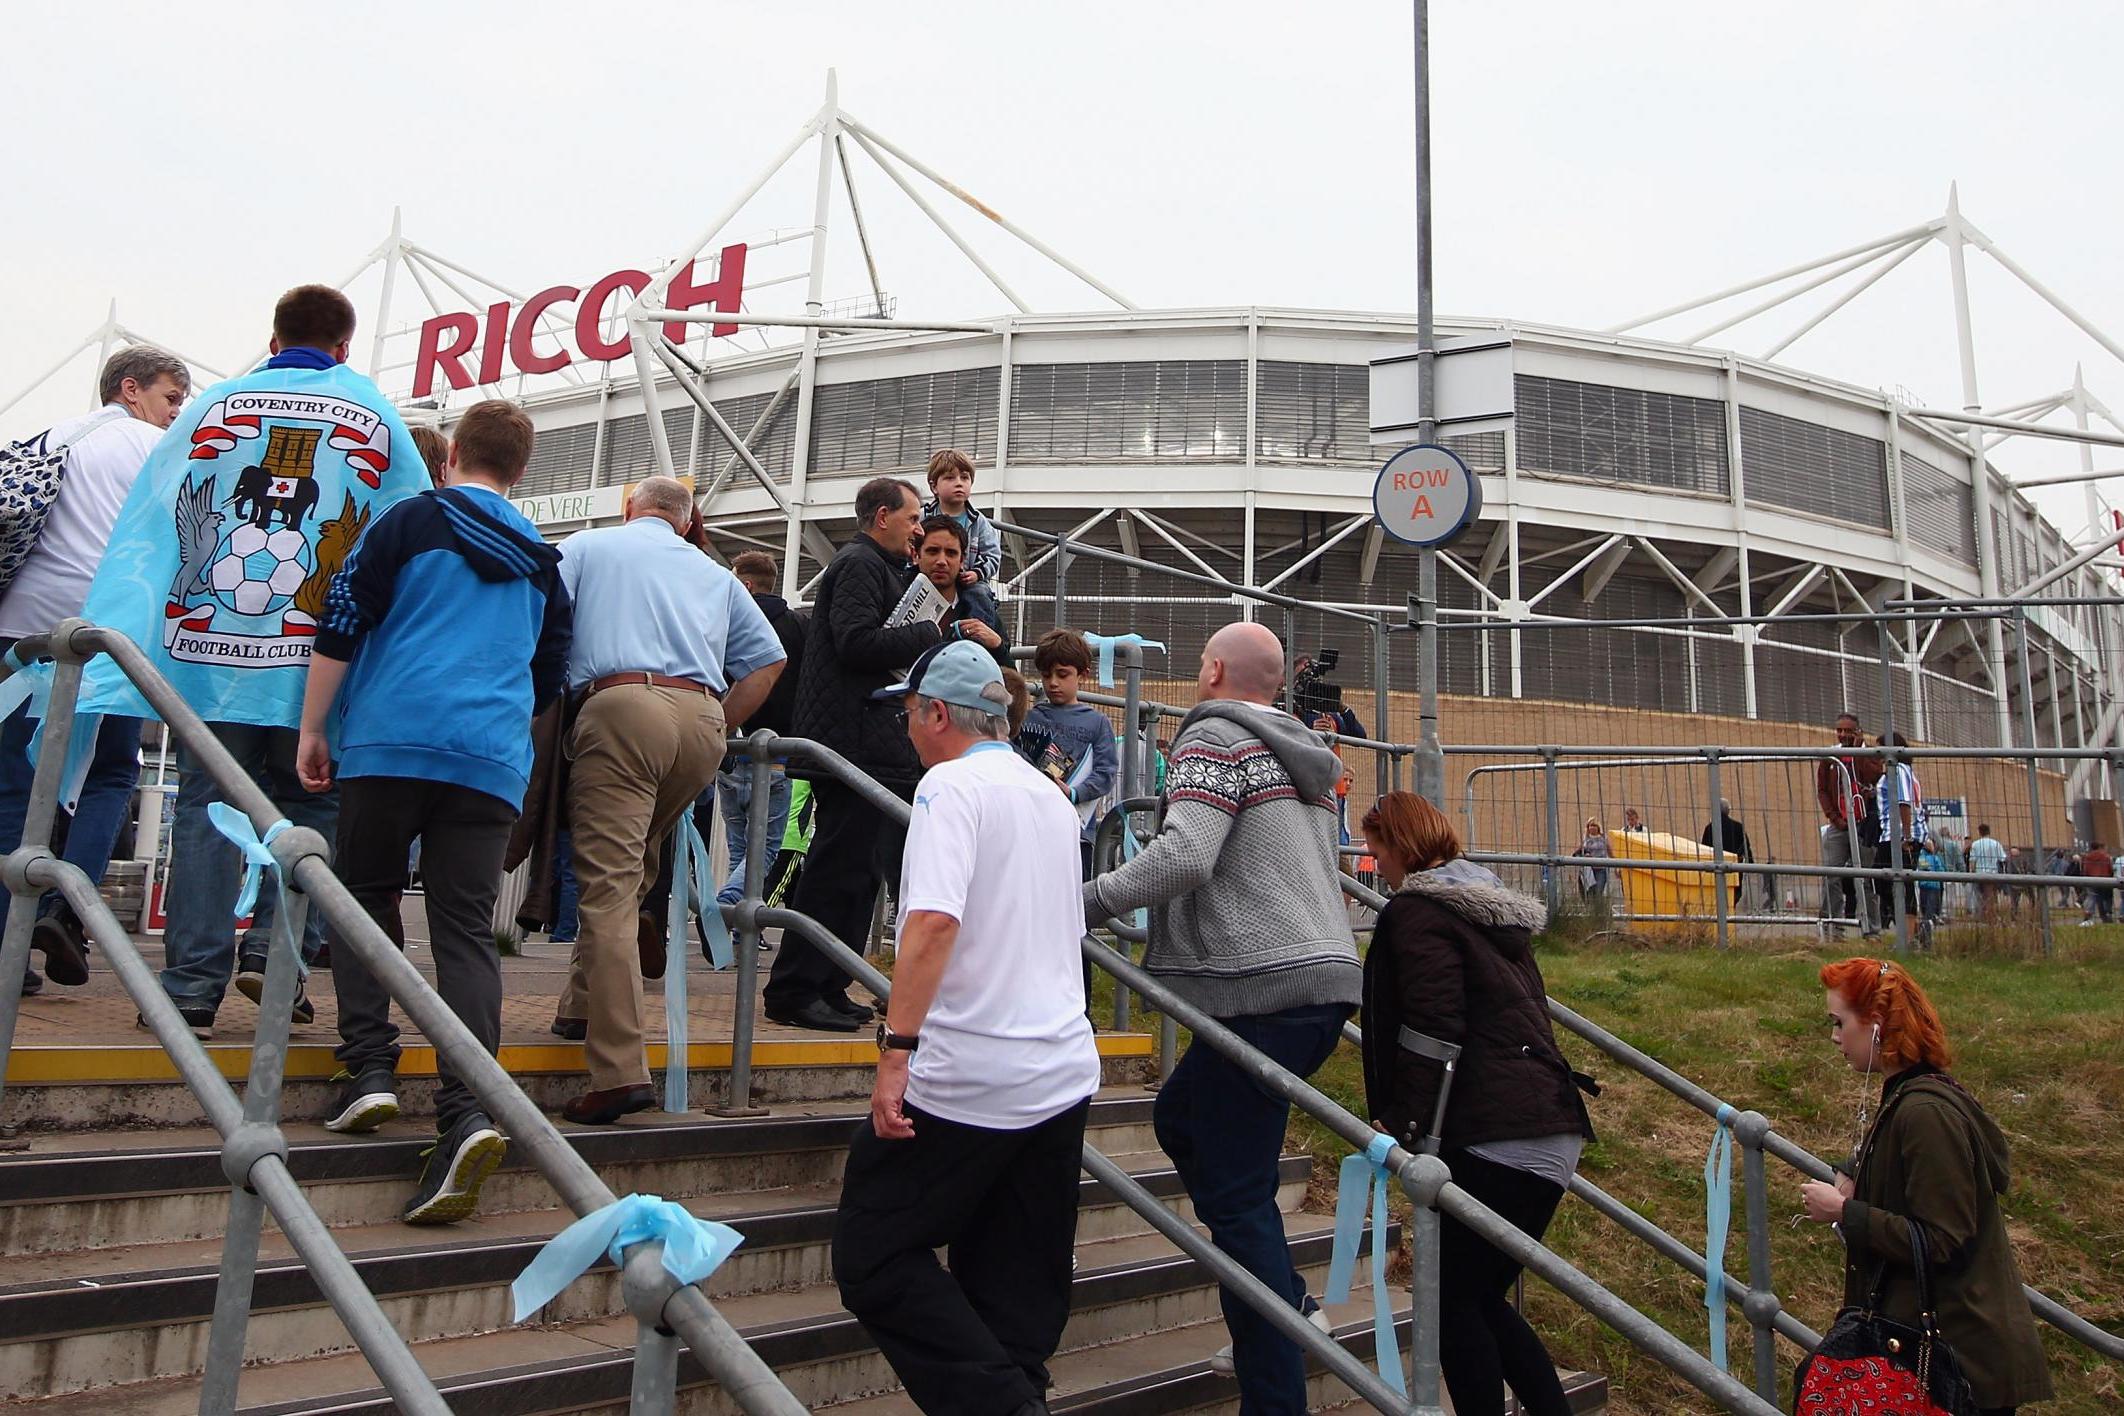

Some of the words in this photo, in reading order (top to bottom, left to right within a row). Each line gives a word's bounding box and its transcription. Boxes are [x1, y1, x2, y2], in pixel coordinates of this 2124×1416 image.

[412, 242, 747, 398] RICOH
[230, 398, 329, 414] COVENTRY
[331, 405, 373, 427] CITY
[1393, 468, 1449, 491] ROW
[549, 495, 594, 521] VERE
[1411, 494, 1434, 520] A
[177, 638, 265, 659] FOOTBALL
[267, 643, 312, 659] CLUB
